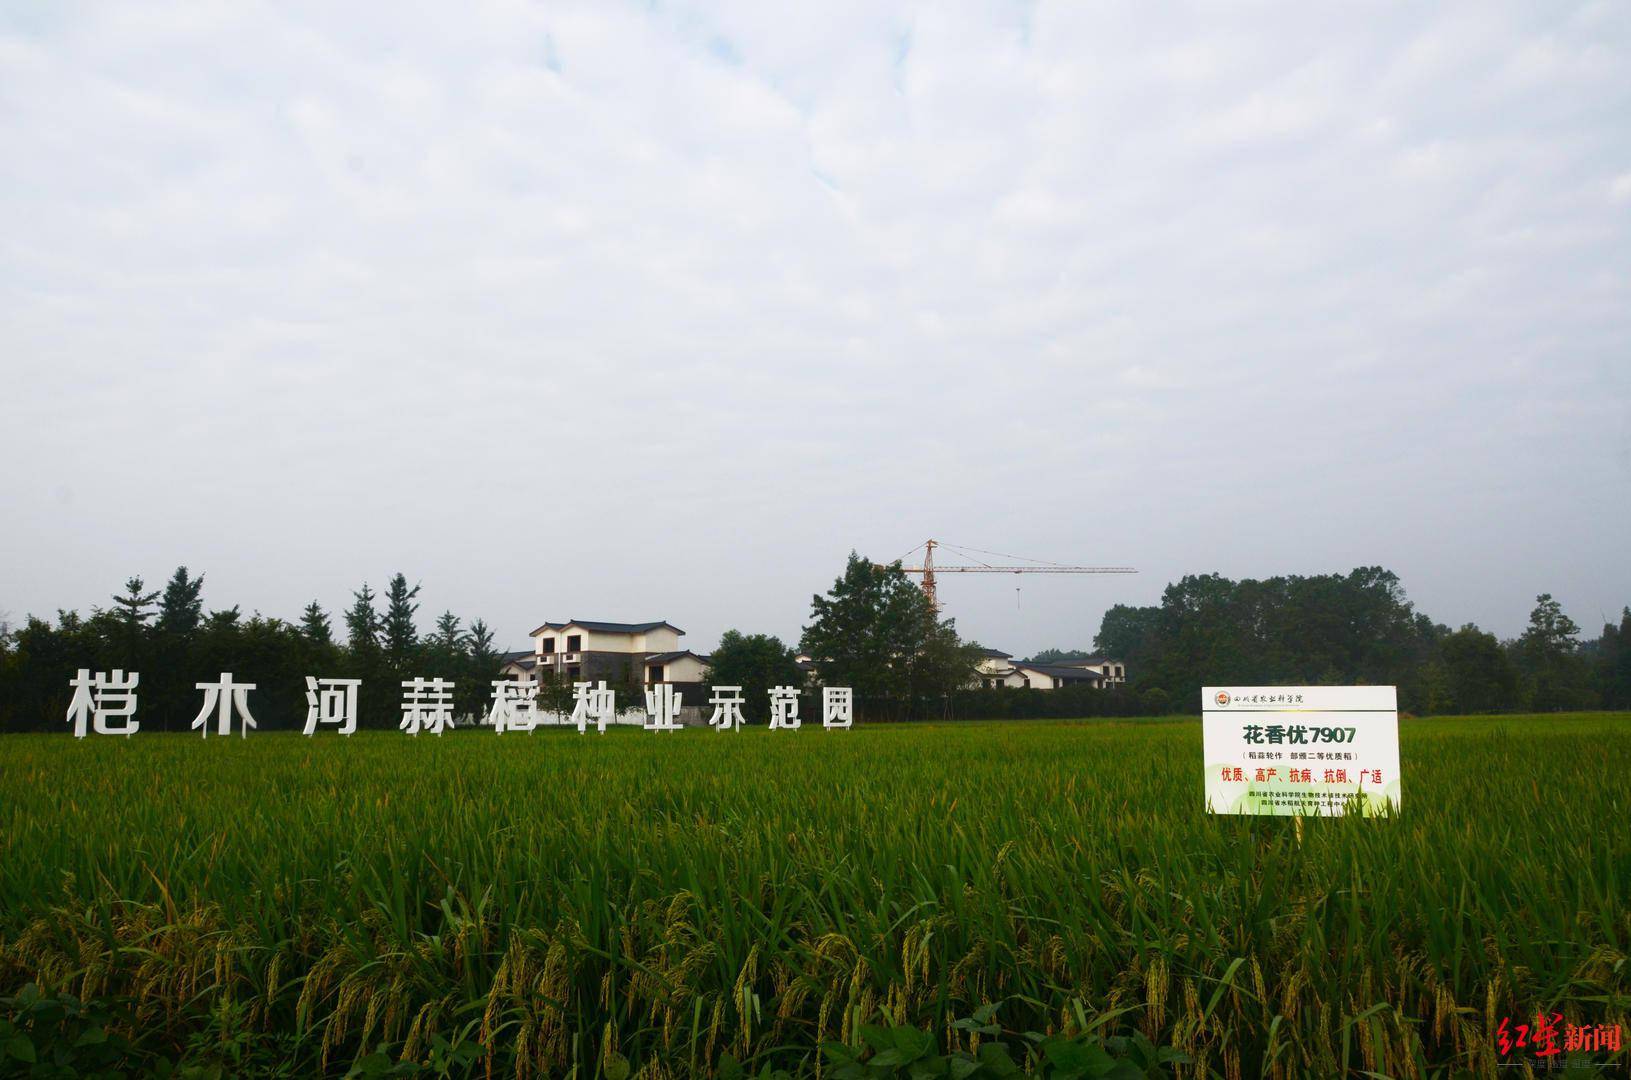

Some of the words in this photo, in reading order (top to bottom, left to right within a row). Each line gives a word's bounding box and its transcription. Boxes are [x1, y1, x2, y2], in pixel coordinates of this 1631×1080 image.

[1243, 725, 1357, 745] 花香优7907
[1221, 767, 1383, 784] 优质、高产、抗病、抗倒、广适
